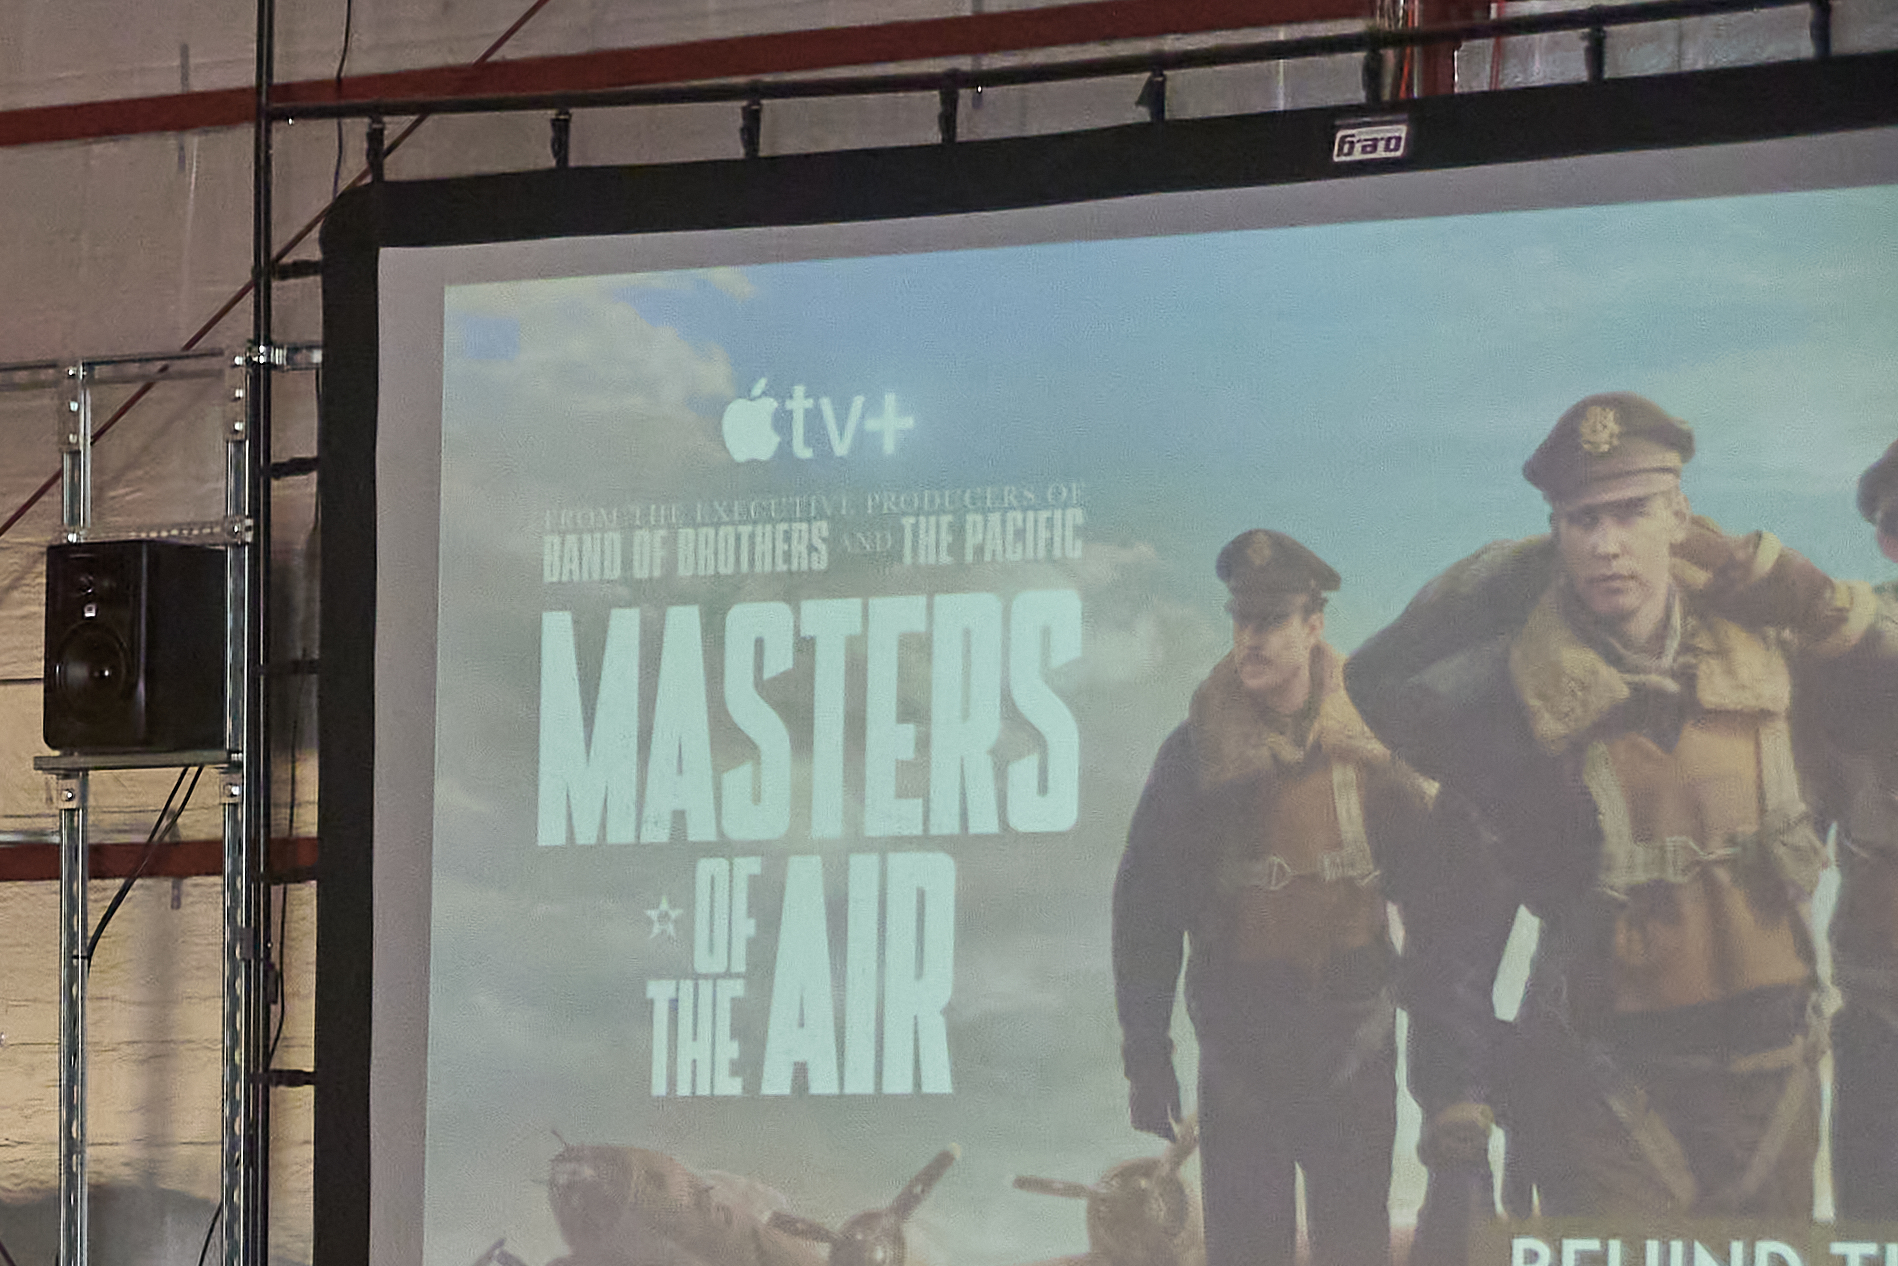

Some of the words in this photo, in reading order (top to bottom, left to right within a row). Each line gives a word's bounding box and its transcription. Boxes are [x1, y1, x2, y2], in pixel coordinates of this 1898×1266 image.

[785, 385, 914, 459] tv+
[543, 532, 621, 583] BAND
[633, 530, 663, 579] OF
[677, 520, 829, 576] BROTHERS
[840, 532, 892, 555] AND
[902, 513, 953, 565] THE
[964, 507, 1083, 562] PACIFIC
[544, 508, 620, 530] FROM
[631, 503, 682, 527] THE
[697, 493, 855, 522] EXECUTIVE
[867, 485, 1036, 515] PRODUCERS
[1048, 481, 1086, 505] OF
[538, 589, 1083, 846] MASTERS
[693, 856, 762, 974] OF
[646, 978, 745, 1097] THE
[759, 851, 956, 1095] AIR
